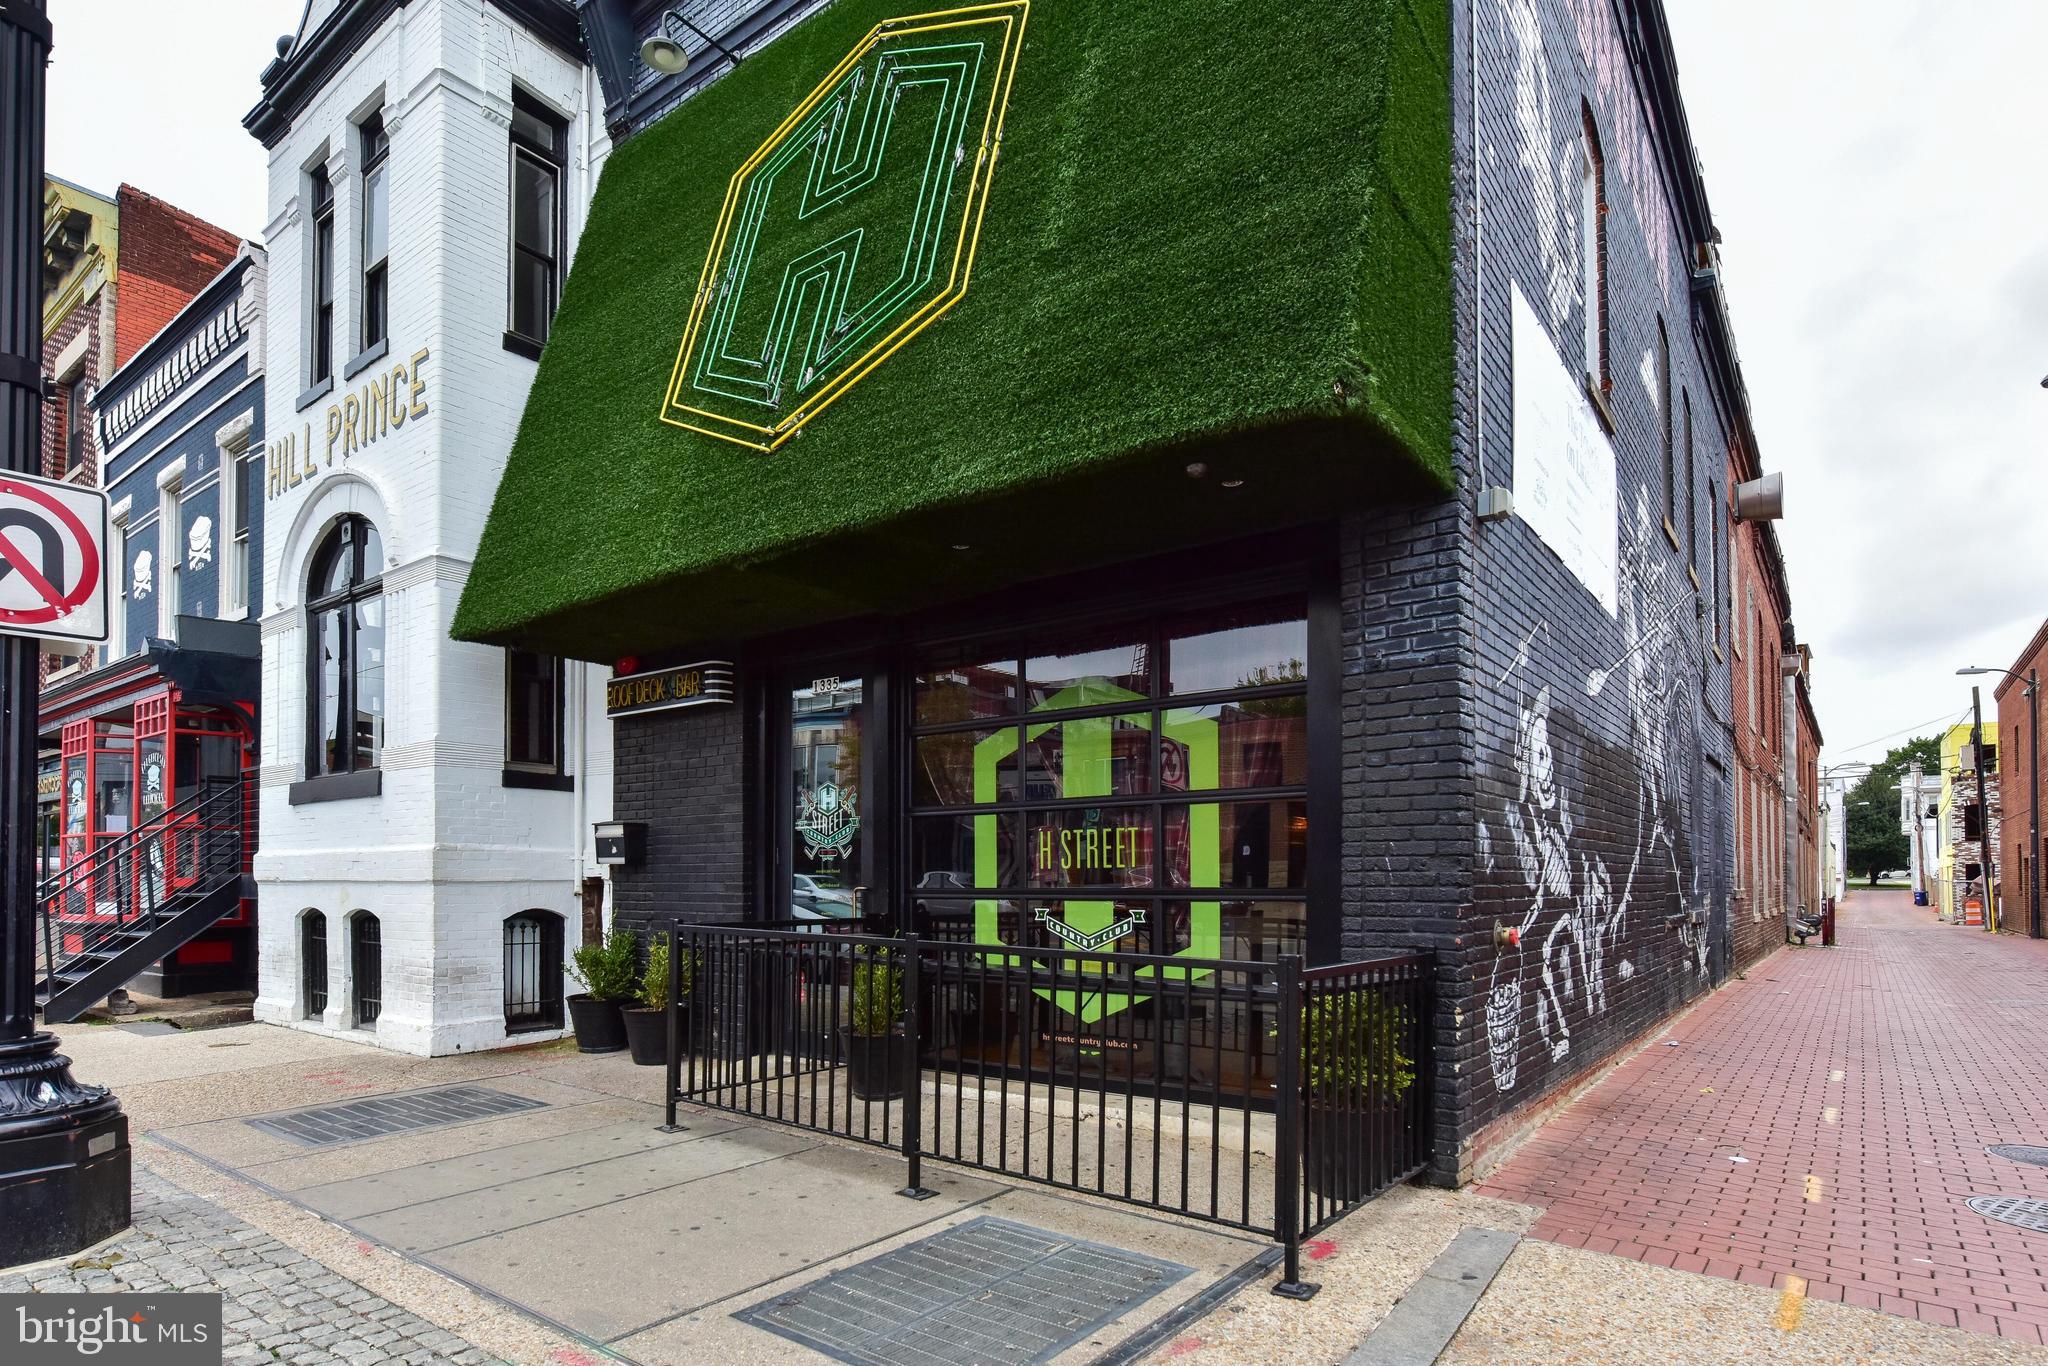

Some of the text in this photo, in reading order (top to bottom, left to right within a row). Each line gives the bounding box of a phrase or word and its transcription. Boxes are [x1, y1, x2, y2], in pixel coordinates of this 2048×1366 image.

[268, 347, 430, 501] HILL PRINCE
[608, 682, 635, 708] ROOF
[635, 677, 665, 704] DECK
[675, 670, 700, 698] BAR
[813, 677, 839, 693] 1335
[820, 786, 837, 812] H
[811, 809, 844, 836] STREET
[1040, 827, 1139, 870] H STREET
[1049, 920, 1128, 948] COUNTRY CLUB
